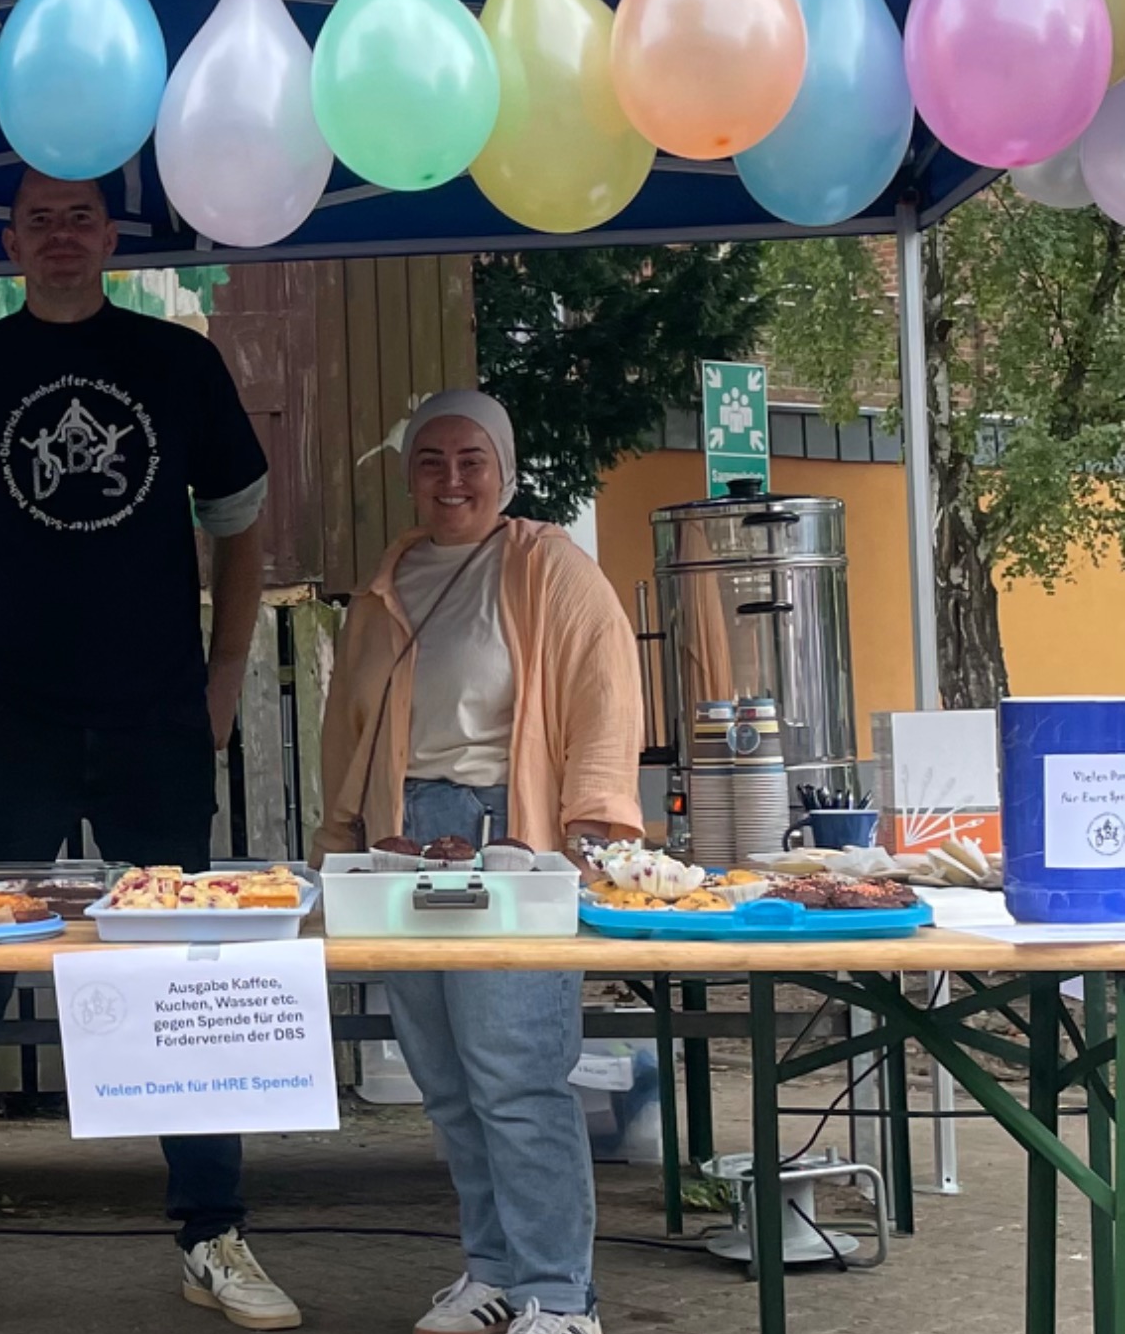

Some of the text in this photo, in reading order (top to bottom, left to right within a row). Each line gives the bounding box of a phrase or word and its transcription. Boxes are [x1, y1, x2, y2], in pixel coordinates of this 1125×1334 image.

[1073, 770, 1108, 783] Vielen
[168, 976, 282, 996] Ausgabe Kaffee,
[155, 994, 298, 1013] Kuchen, Wasser etc.
[154, 1010, 304, 1033] gegen Spende für den
[156, 1027, 305, 1047] Förderverein der DBS
[96, 1074, 313, 1097] Vielen Dank für IHRE Spende!
